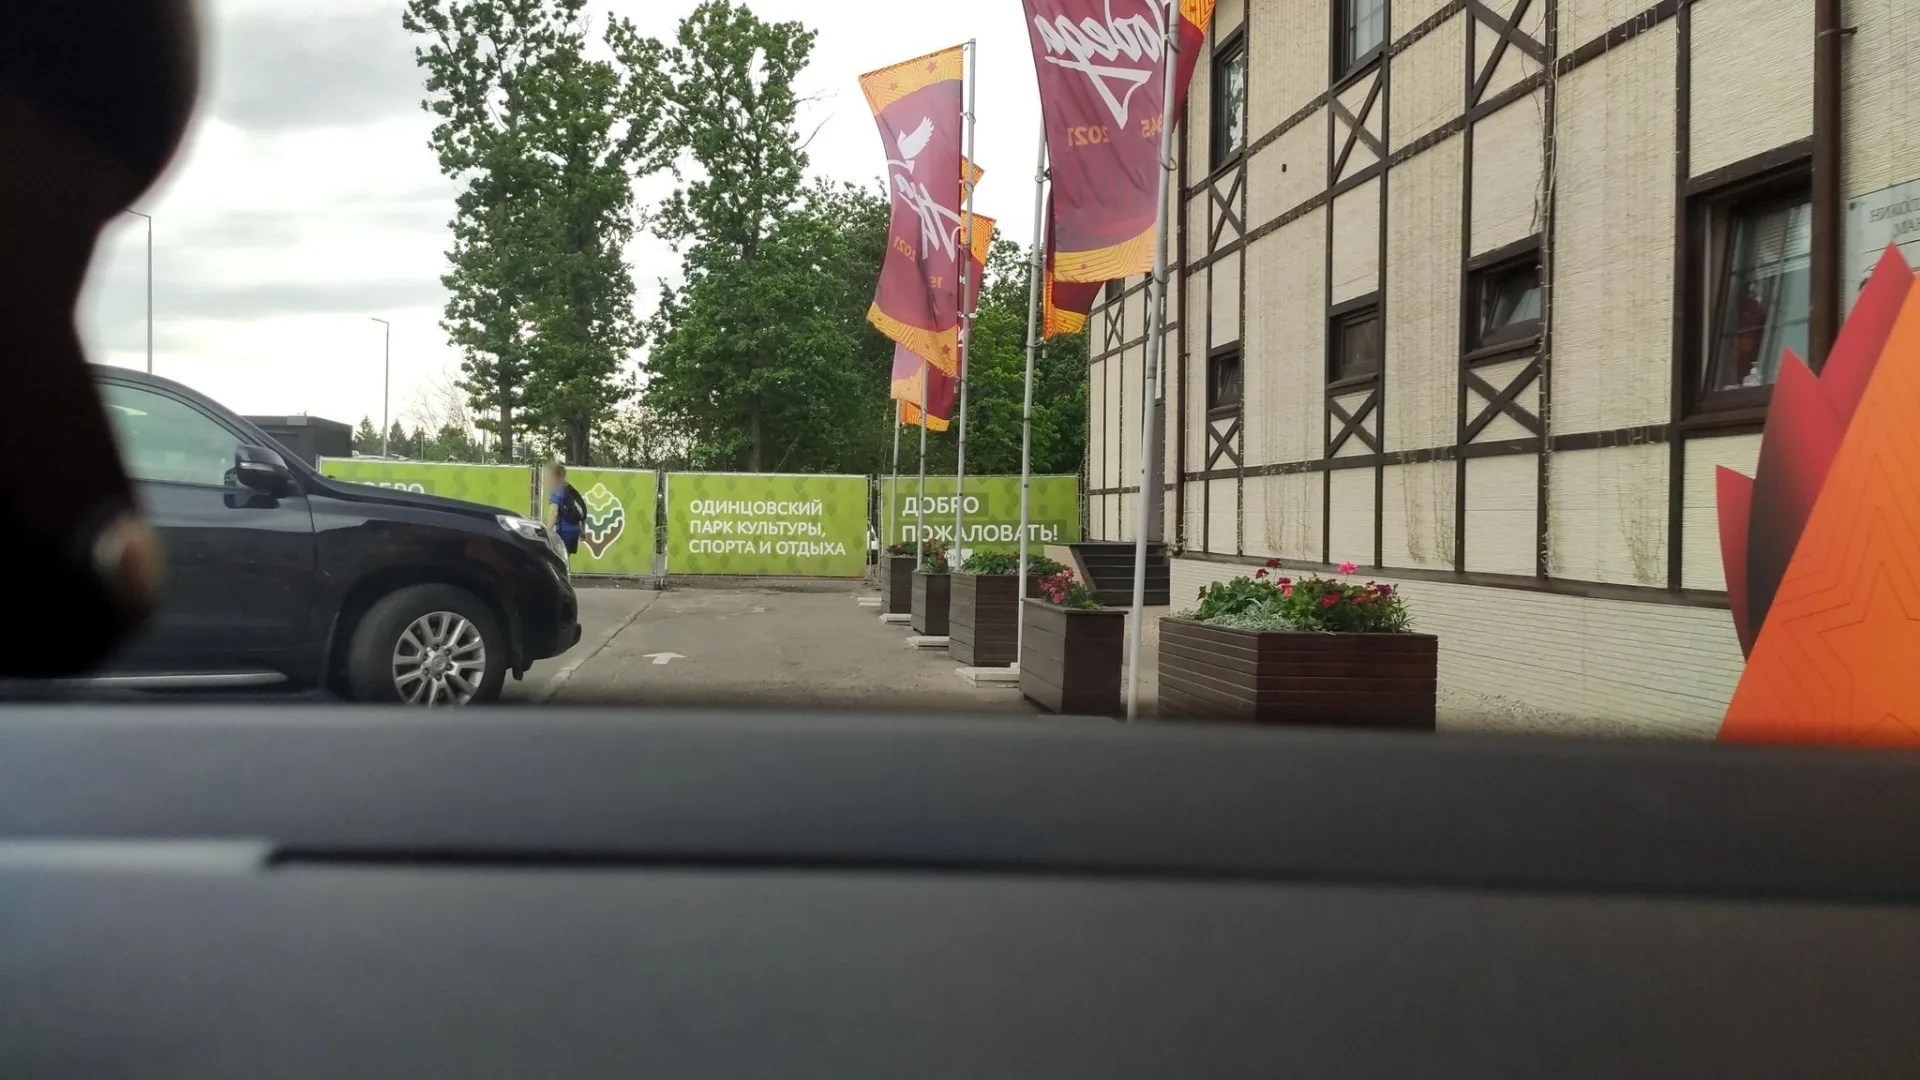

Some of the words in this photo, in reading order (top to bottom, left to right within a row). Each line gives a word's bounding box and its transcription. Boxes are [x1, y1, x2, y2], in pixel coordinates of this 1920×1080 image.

[689, 499, 823, 516] ОДИНЦОВСКИЙ
[690, 520, 733, 534] ПАРК
[737, 521, 826, 538] КУЛЬТУРЫ,
[689, 540, 756, 553] СПОРТА
[759, 541, 771, 554] И
[776, 541, 847, 557] ОТДЫХА
